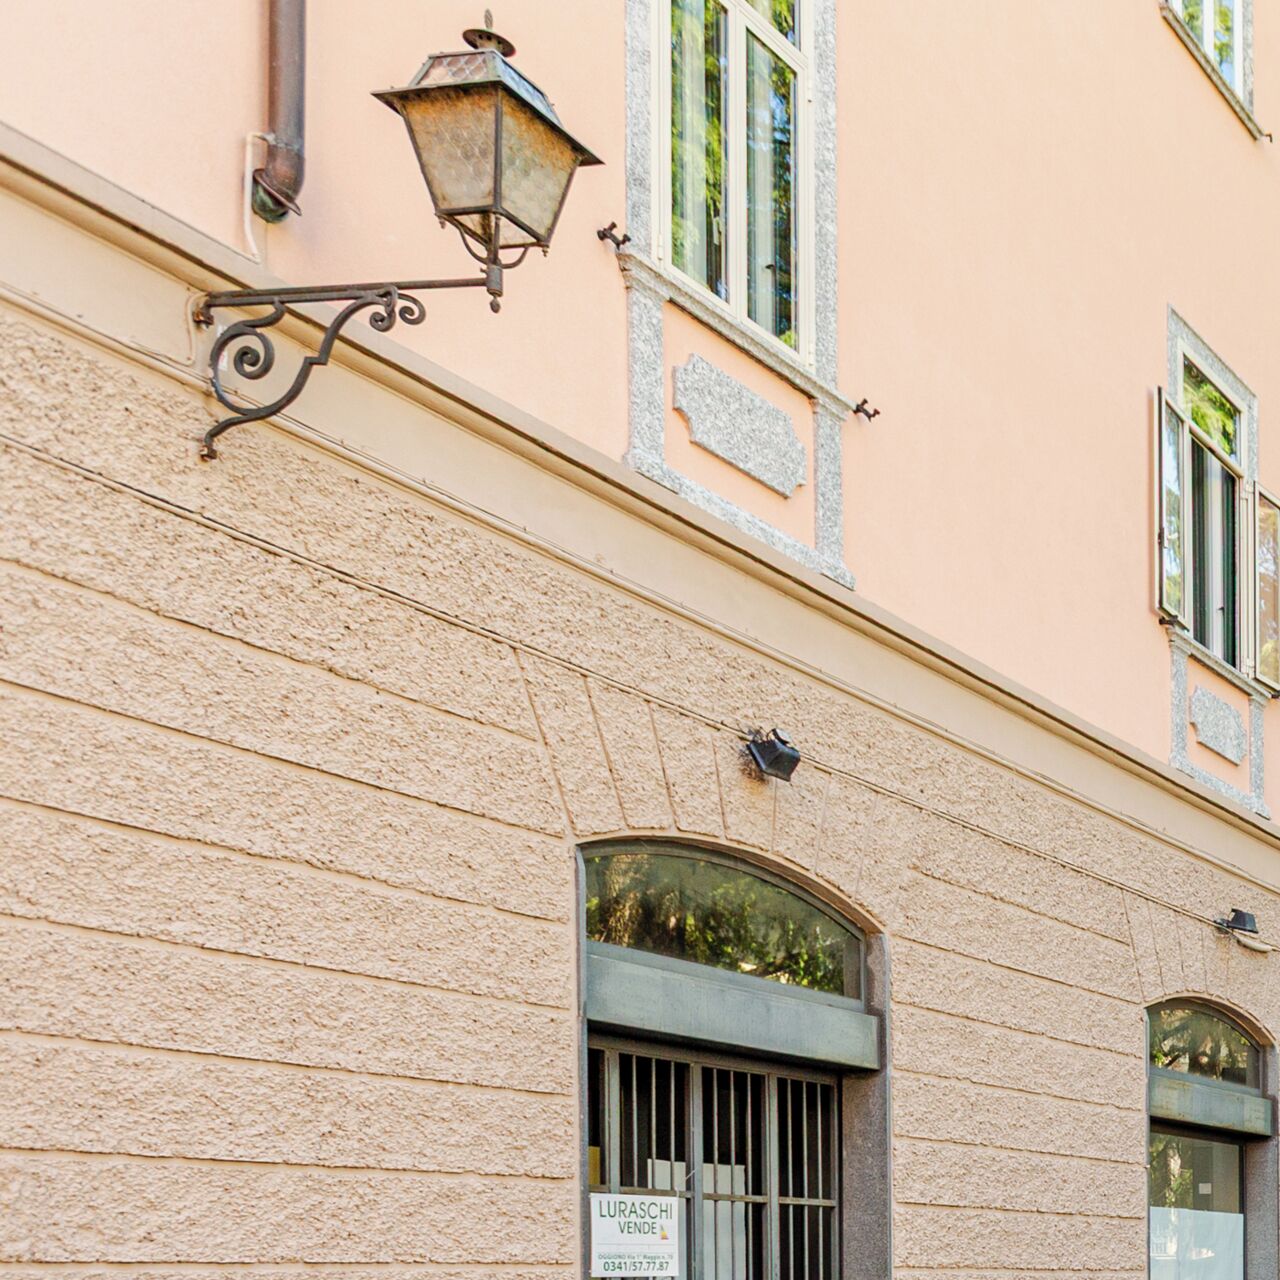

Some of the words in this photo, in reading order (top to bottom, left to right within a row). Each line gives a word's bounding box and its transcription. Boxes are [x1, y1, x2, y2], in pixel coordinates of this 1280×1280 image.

[598, 1199, 673, 1220] LURASCHI
[618, 1220, 658, 1235] VENDE
[603, 1261, 669, 1272] 0341/57.77.87
